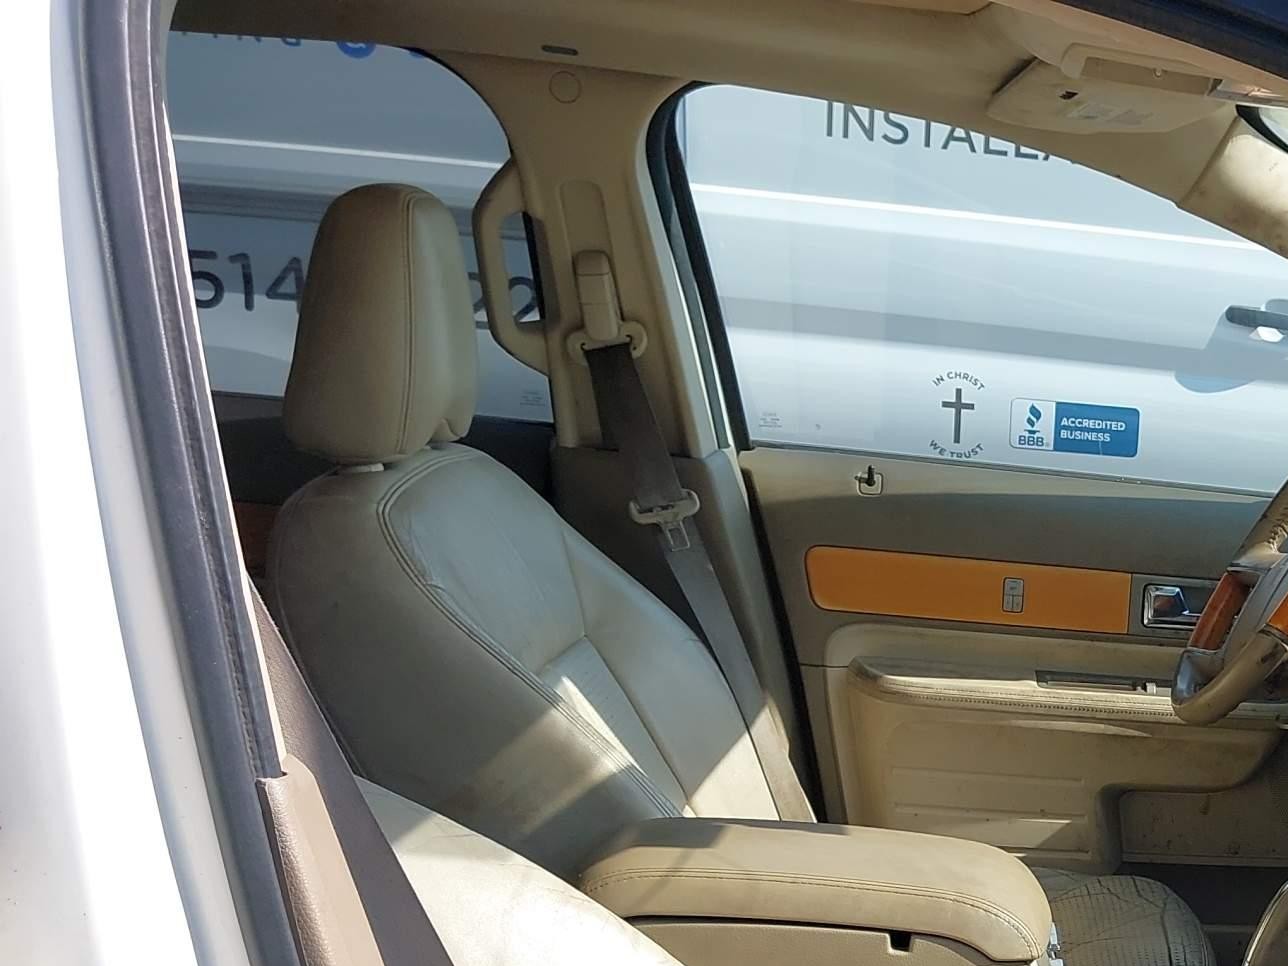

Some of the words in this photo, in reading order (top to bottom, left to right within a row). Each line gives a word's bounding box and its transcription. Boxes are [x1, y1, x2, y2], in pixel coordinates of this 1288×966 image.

[932, 375, 945, 387] IN
[947, 371, 985, 391] CHRIST
[1060, 417, 1126, 431] ACCREDITED
[1018, 435, 1045, 447] BBB
[1060, 429, 1111, 442] BUSINESS
[929, 439, 946, 456] WE
[950, 442, 985, 459] TRUST
